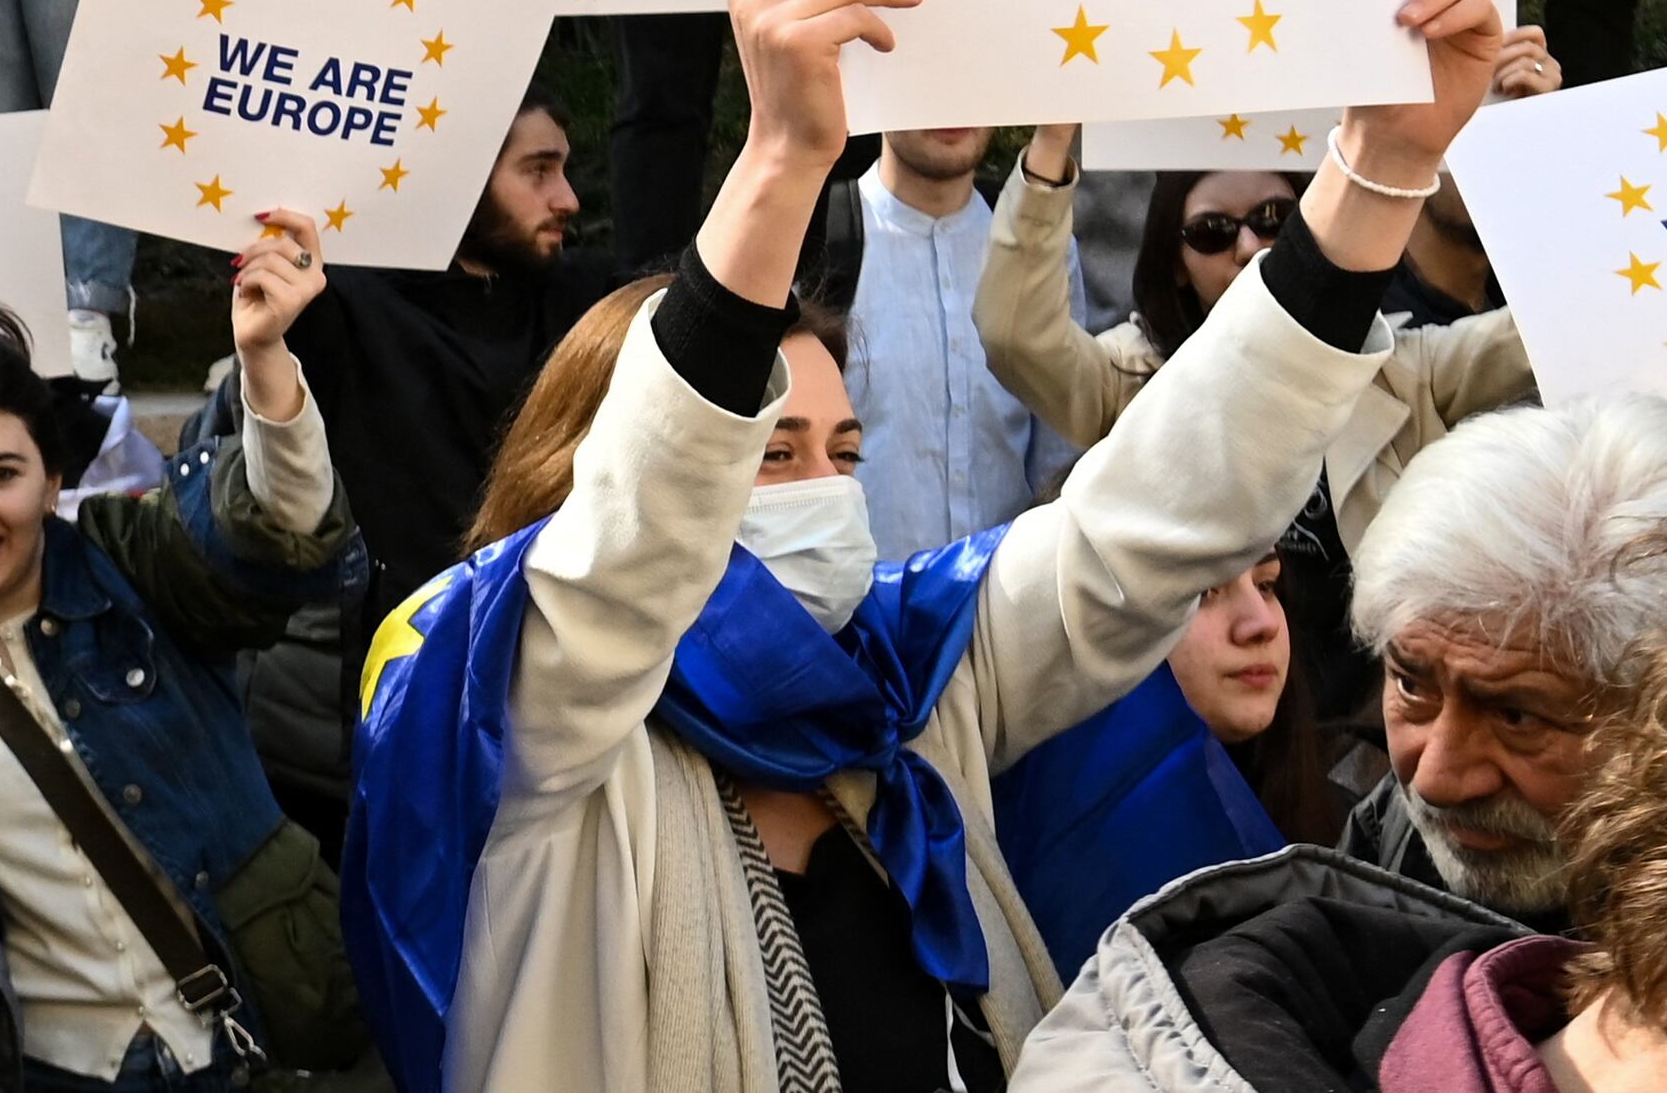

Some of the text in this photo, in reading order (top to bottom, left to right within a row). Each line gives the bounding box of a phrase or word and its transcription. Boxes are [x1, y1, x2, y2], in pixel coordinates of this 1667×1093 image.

[219, 33, 413, 107] WE ARE
[202, 76, 403, 147] EUROPE
